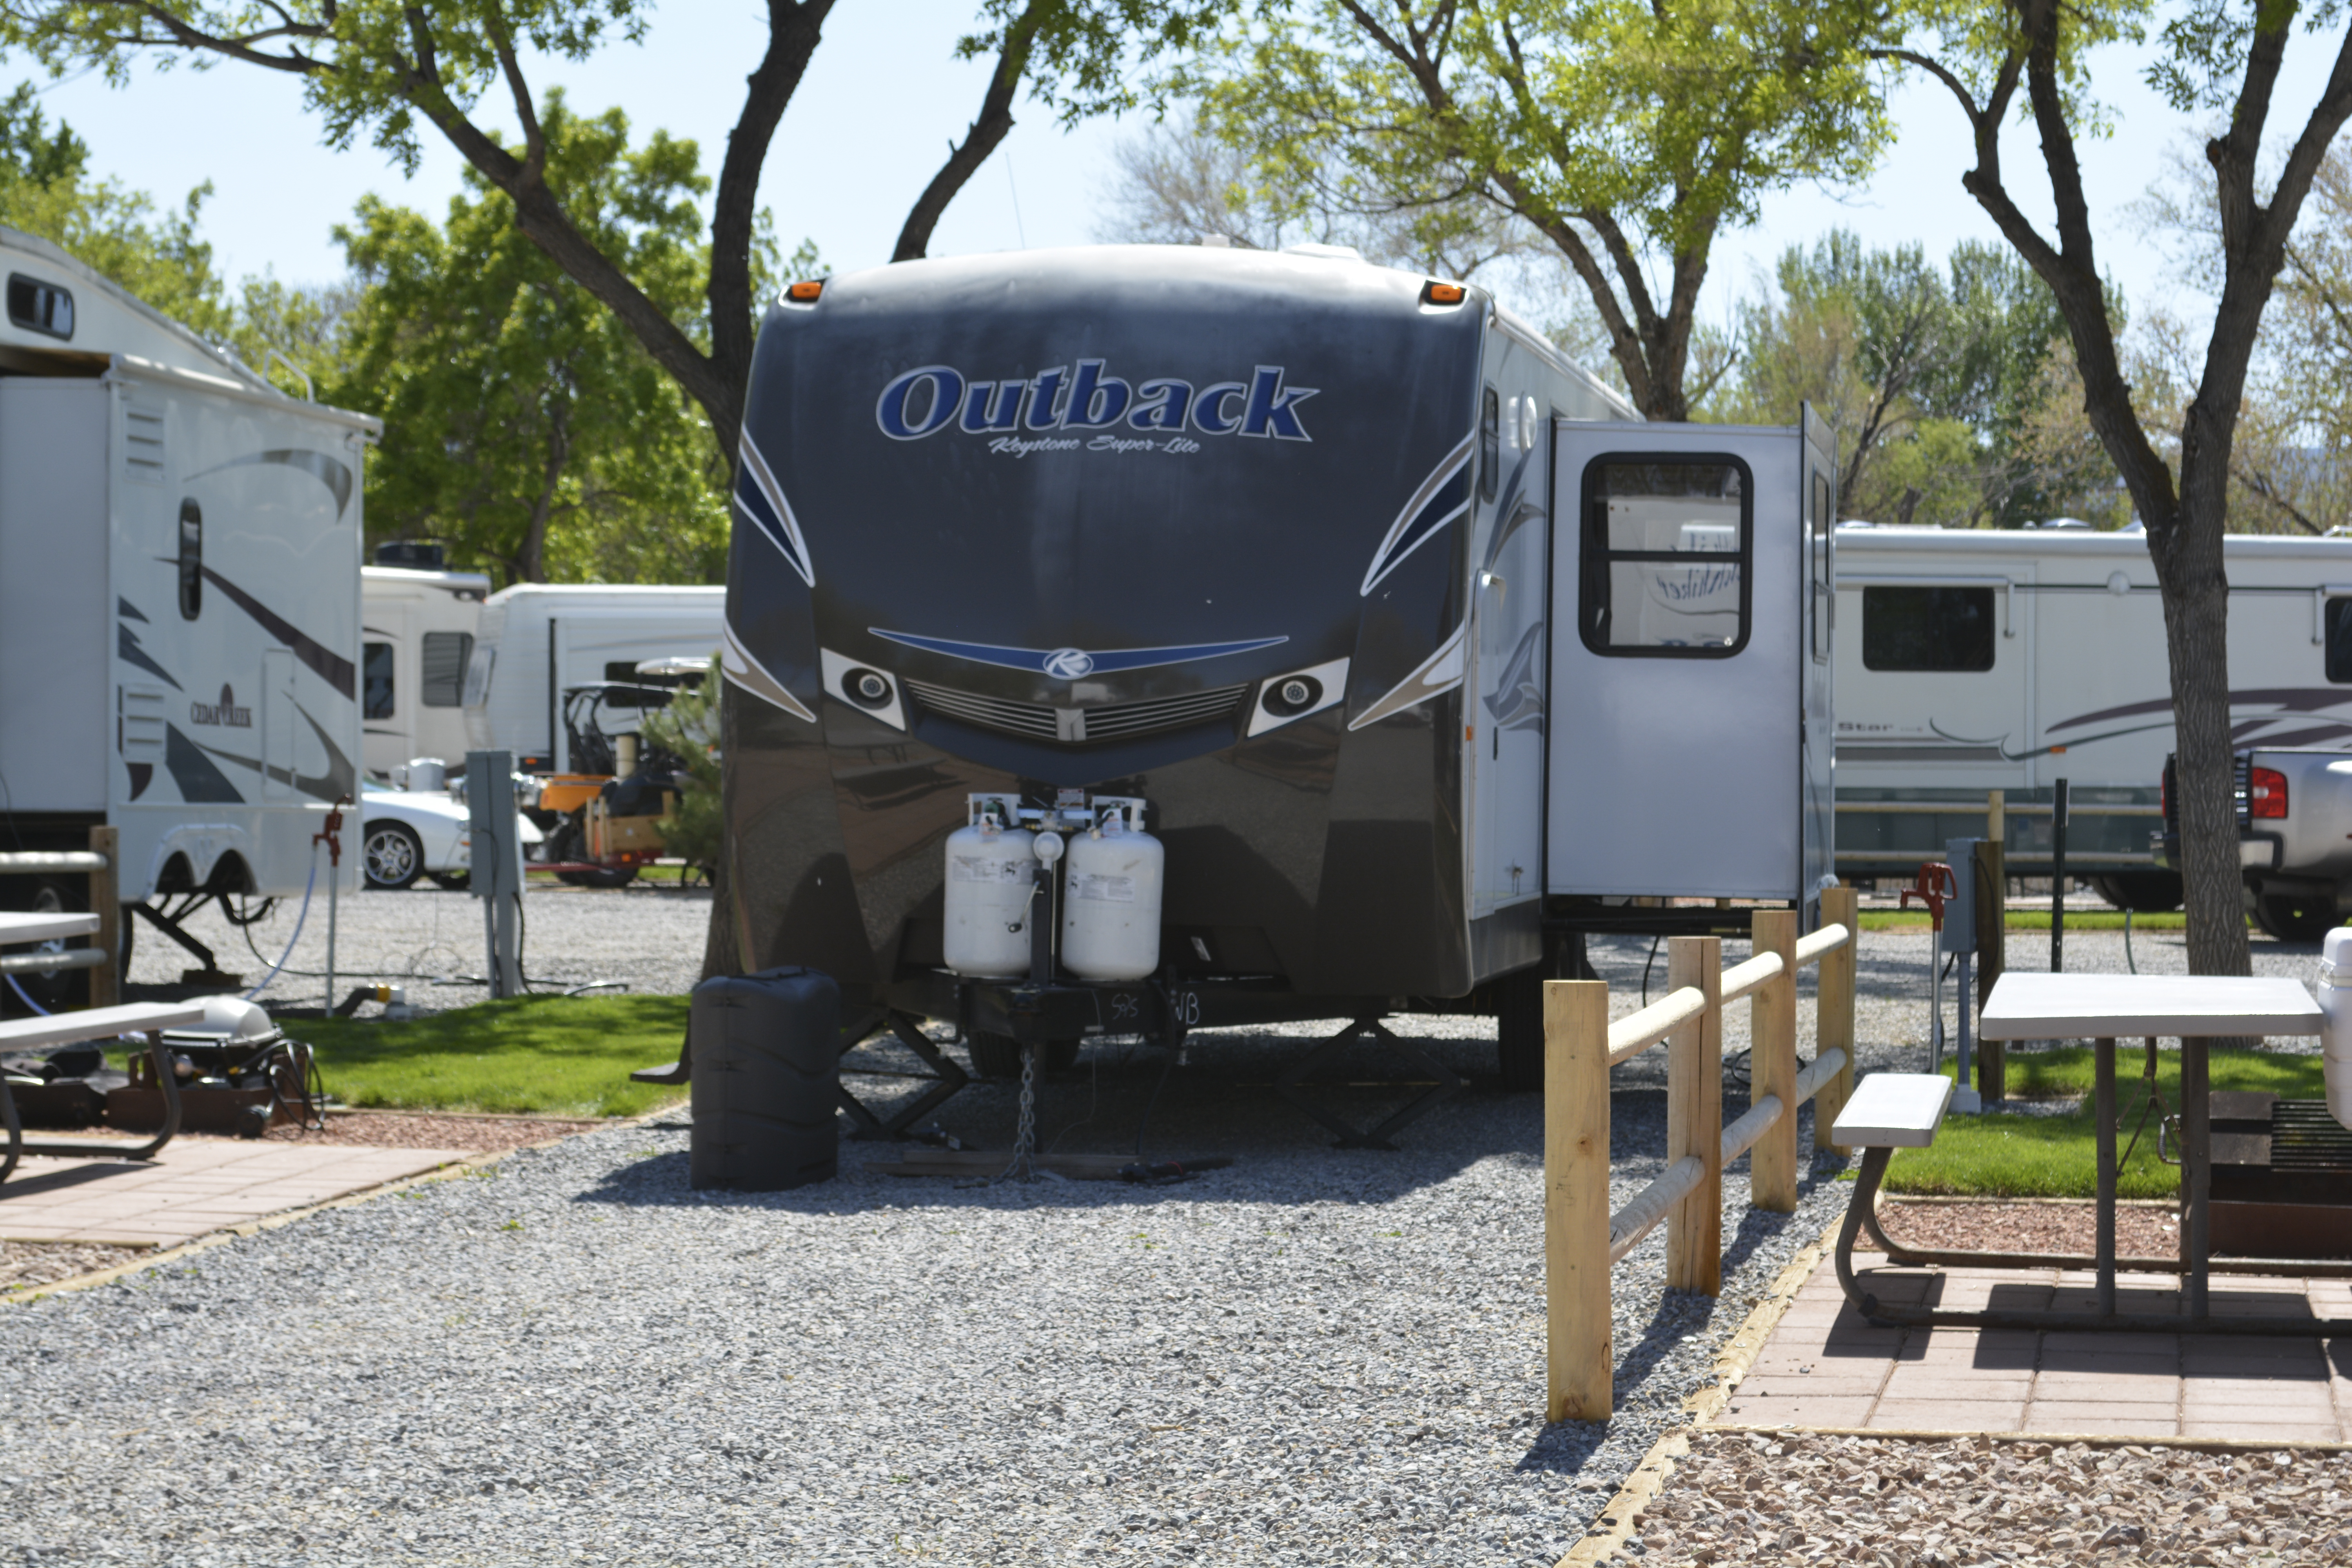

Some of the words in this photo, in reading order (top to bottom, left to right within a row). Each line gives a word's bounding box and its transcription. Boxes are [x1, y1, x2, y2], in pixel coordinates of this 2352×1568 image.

[875, 358, 1320, 442] Outback
[988, 436, 1081, 459] Keystone
[191, 701, 220, 725] CEDAR
[221, 705, 252, 728] CREEK
[1838, 721, 1893, 731] Star
